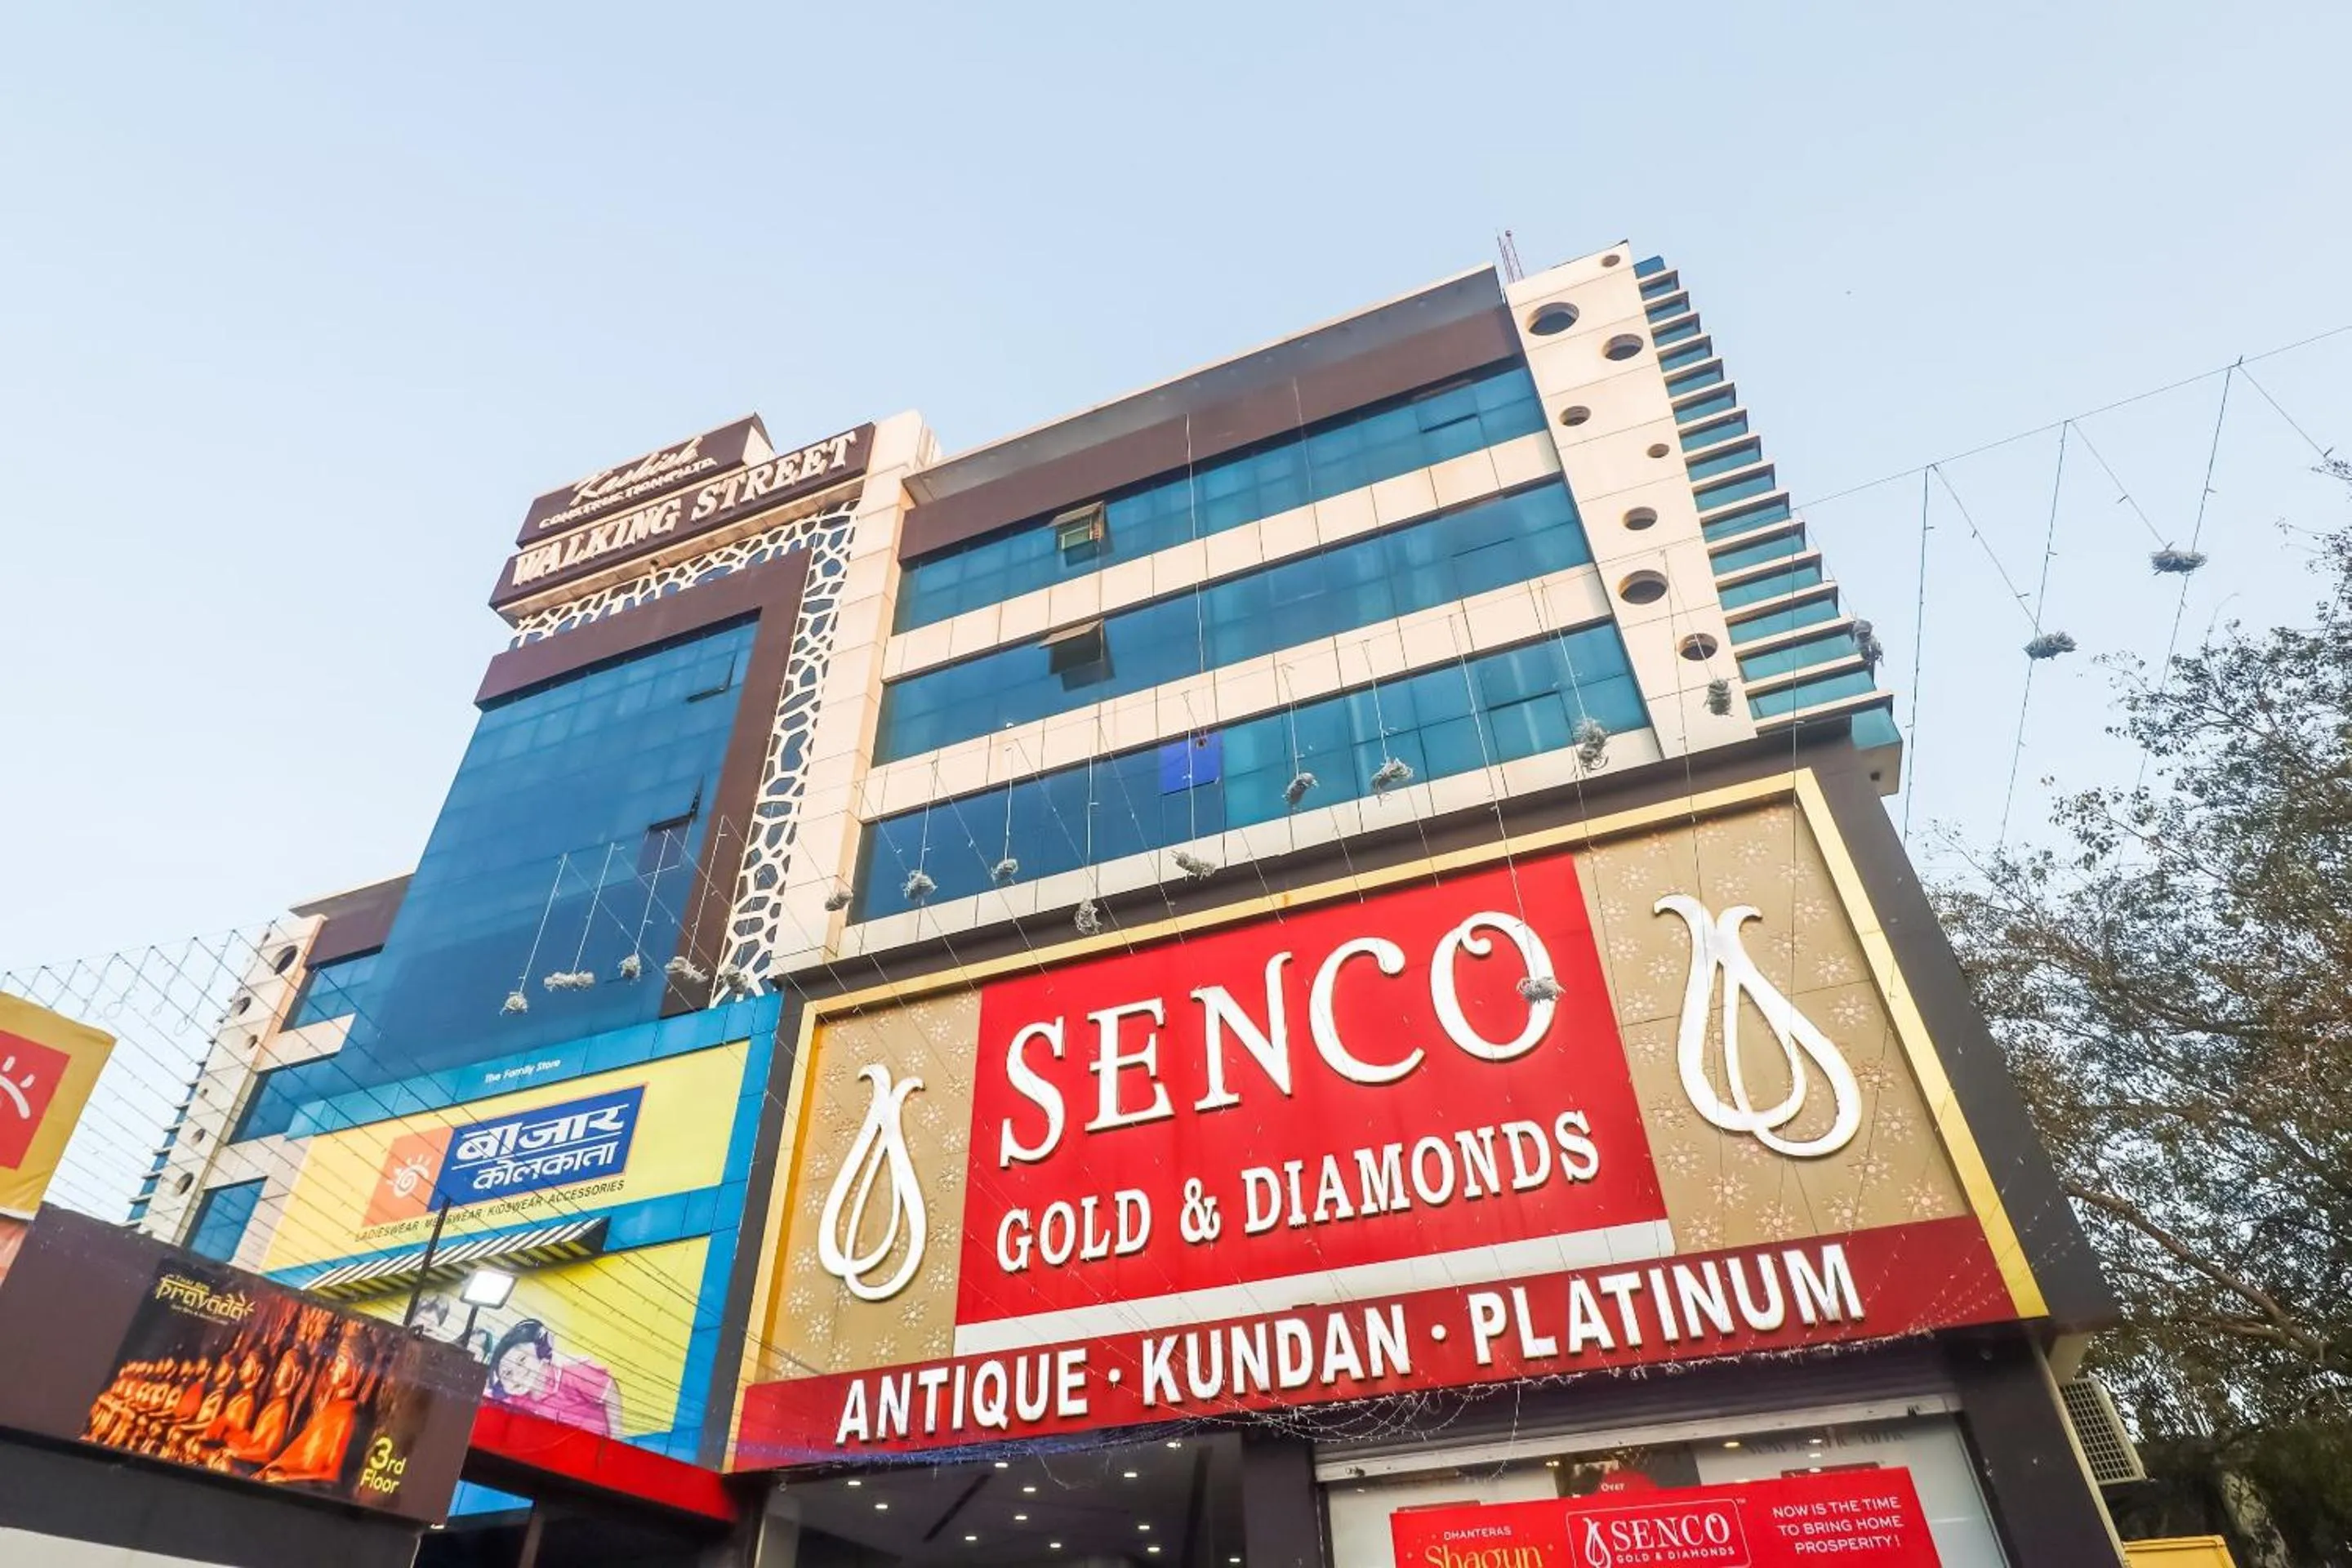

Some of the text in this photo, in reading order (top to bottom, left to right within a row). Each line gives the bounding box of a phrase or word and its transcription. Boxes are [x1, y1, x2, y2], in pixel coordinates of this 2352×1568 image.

[512, 430, 857, 586] WALKING STREET
[999, 911, 1557, 1168] SENCO
[456, 1104, 630, 1160] बाजार
[472, 1142, 620, 1192] कोलकाता
[548, 1179, 625, 1203] ACCESSORIES
[996, 1109, 1602, 1272] GOLD & DIAMONDS
[835, 1243, 1867, 1446] ANTIQUE KUNDAN PLATINUM
[370, 1437, 408, 1476] 3rd
[359, 1468, 400, 1494] Floor
[1772, 1495, 1902, 1519] NOW IS THE TIME
[1777, 1514, 1905, 1536] TO BRING HOME
[1443, 1526, 1512, 1541] DHANTERAS
[1610, 1512, 1731, 1552] SENCO
[1616, 1552, 1650, 1563] GOLD
[1668, 1546, 1735, 1560] DIAMONDS
